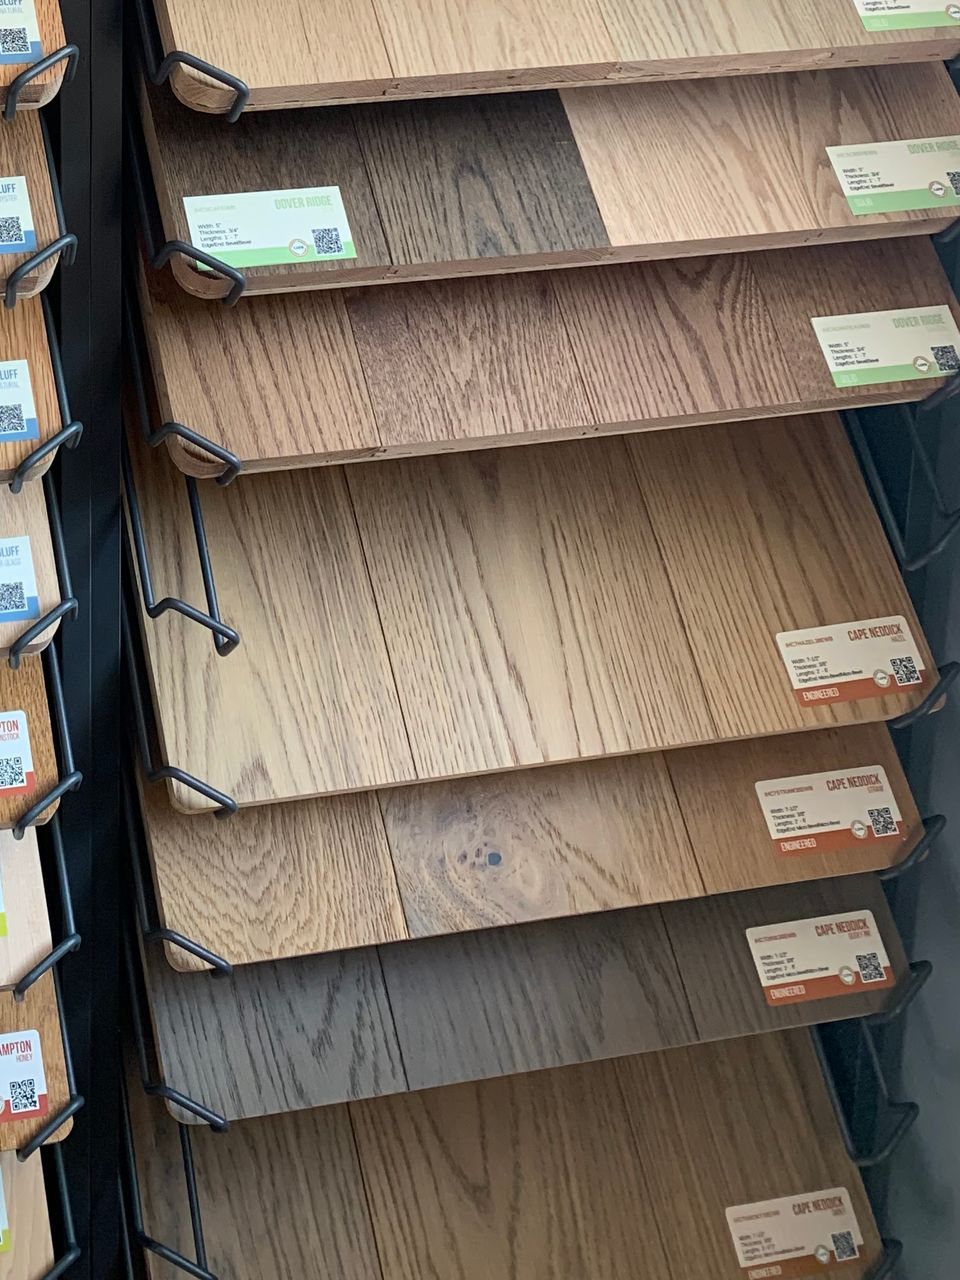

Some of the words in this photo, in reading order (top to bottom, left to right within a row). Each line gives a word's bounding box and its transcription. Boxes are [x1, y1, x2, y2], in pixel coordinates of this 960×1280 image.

[273, 197, 305, 209] DOVER
[305, 195, 333, 206] RIDGE
[847, 628, 869, 641] CAPE
[868, 623, 903, 636] NEDDICK
[825, 778, 847, 790] CAPE
[846, 773, 881, 787] NEDDICK
[814, 923, 835, 936] CAPE
[834, 917, 868, 932] NEDDICK
[15, 1052, 32, 1062] HONEY
[792, 1200, 812, 1216] CAPE
